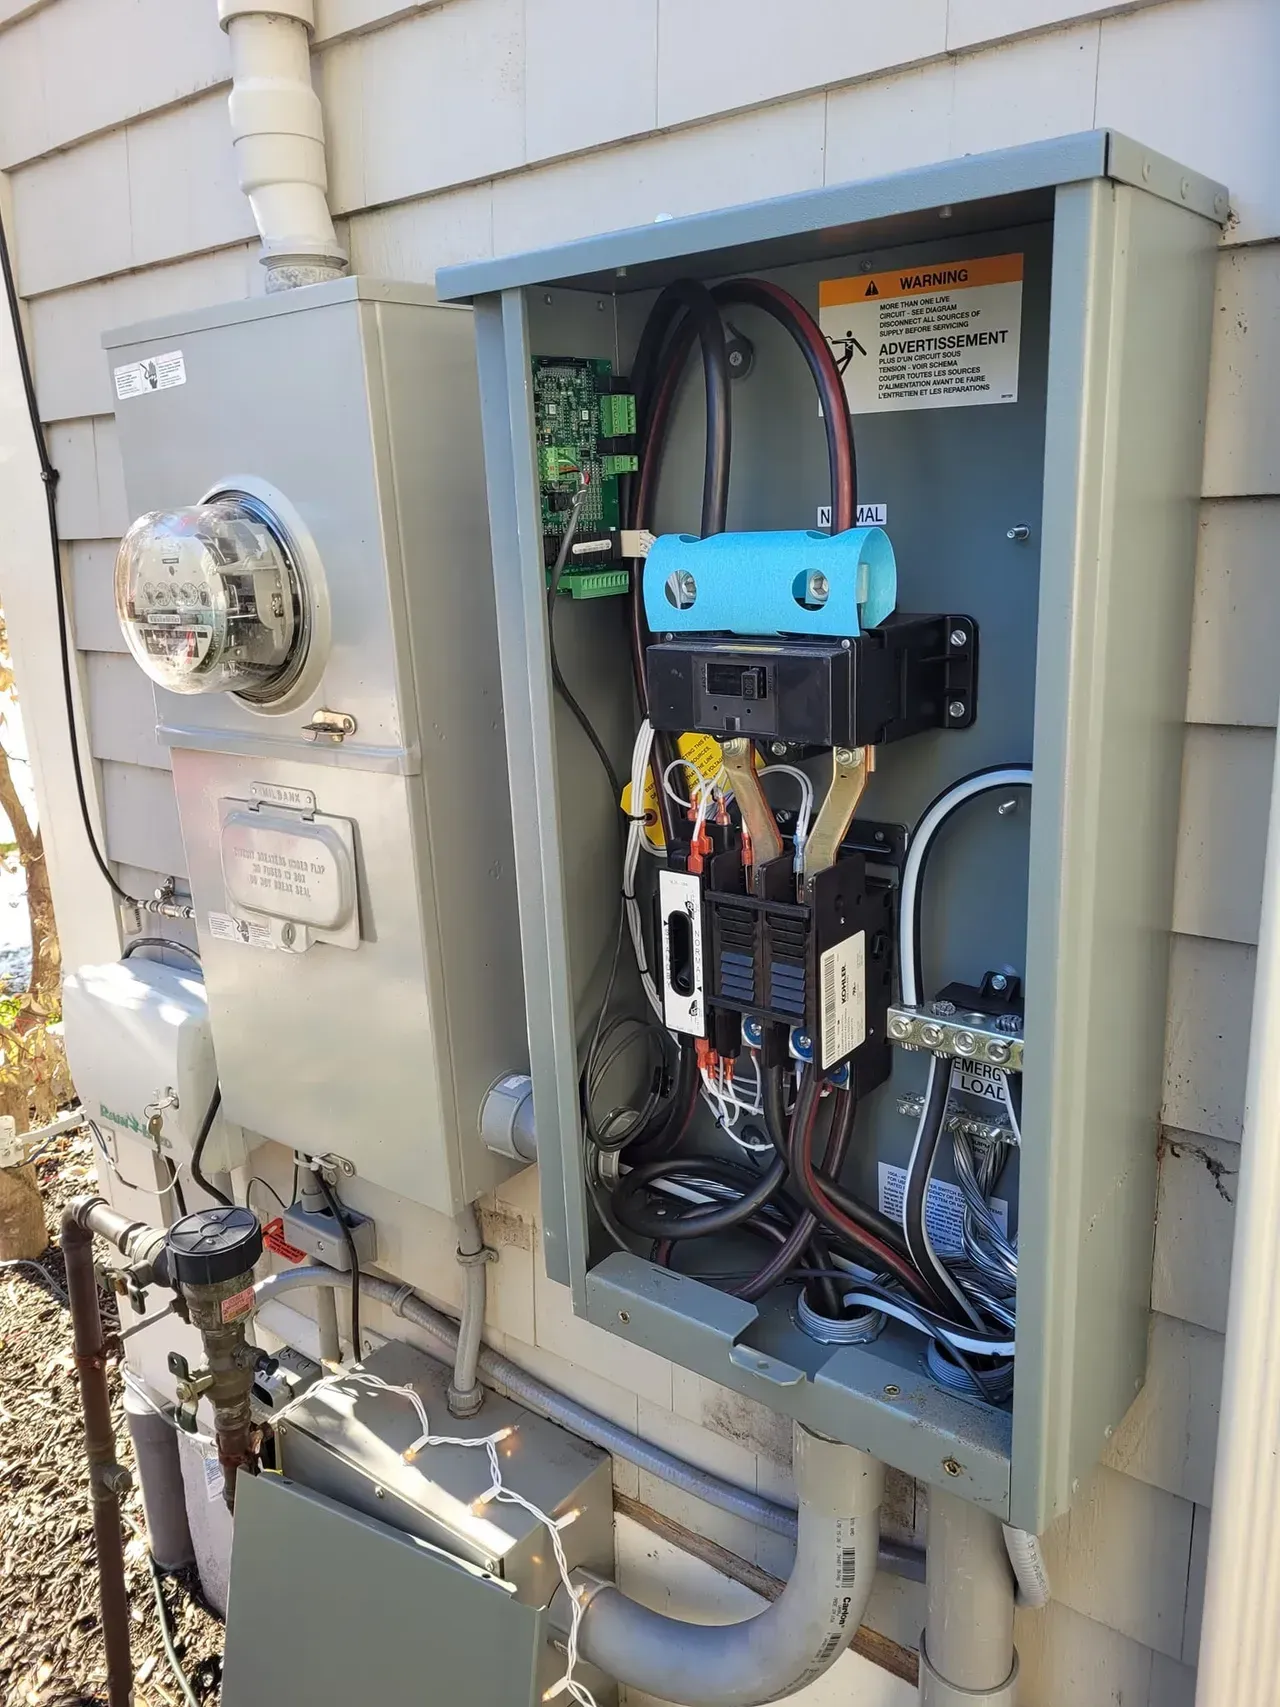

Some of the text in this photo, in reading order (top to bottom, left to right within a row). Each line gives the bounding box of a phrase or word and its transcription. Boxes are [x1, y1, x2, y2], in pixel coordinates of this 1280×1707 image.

[900, 268, 968, 290] WARNING
[880, 302, 899, 310] MORE
[901, 300, 918, 308] THAN
[936, 296, 950, 304] LIVE
[880, 310, 906, 320] CIRCUIT
[926, 304, 957, 314] DIAGRAM
[880, 317, 922, 328] DISCONNECT
[936, 312, 969, 321] SOURCES
[880, 321, 969, 337] SUPPLY BEFORE SERVICING
[879, 330, 1008, 356] ADVERTISSEMENT
[914, 352, 941, 361] CIRCUIT
[879, 365, 907, 373] TENSION
[912, 362, 928, 370] VOIR
[929, 360, 958, 369] SCHEMA
[879, 374, 905, 382] COUPER
[907, 370, 932, 379] TOUTES
[948, 366, 980, 375] SOURCES
[878, 389, 918, 399] L'ENTRETIEN
[943, 384, 990, 394] REPARATIONS
[879, 380, 931, 391] D'ALIMENTATION
[932, 378, 953, 386] AVANT
[821, 507, 883, 524] NMAL
[260, 788, 300, 803] MILBANK
[288, 859, 308, 872] UNDER
[310, 863, 325, 874] FLAP
[249, 874, 257, 885] DO
[260, 877, 271, 887] NOT
[274, 880, 293, 894] BREAK
[294, 872, 306, 883] BOX
[954, 1057, 1001, 1081] EMERG
[939, 1186, 957, 1195] SWITCH
[839, 1597, 851, 1625] Carlon
